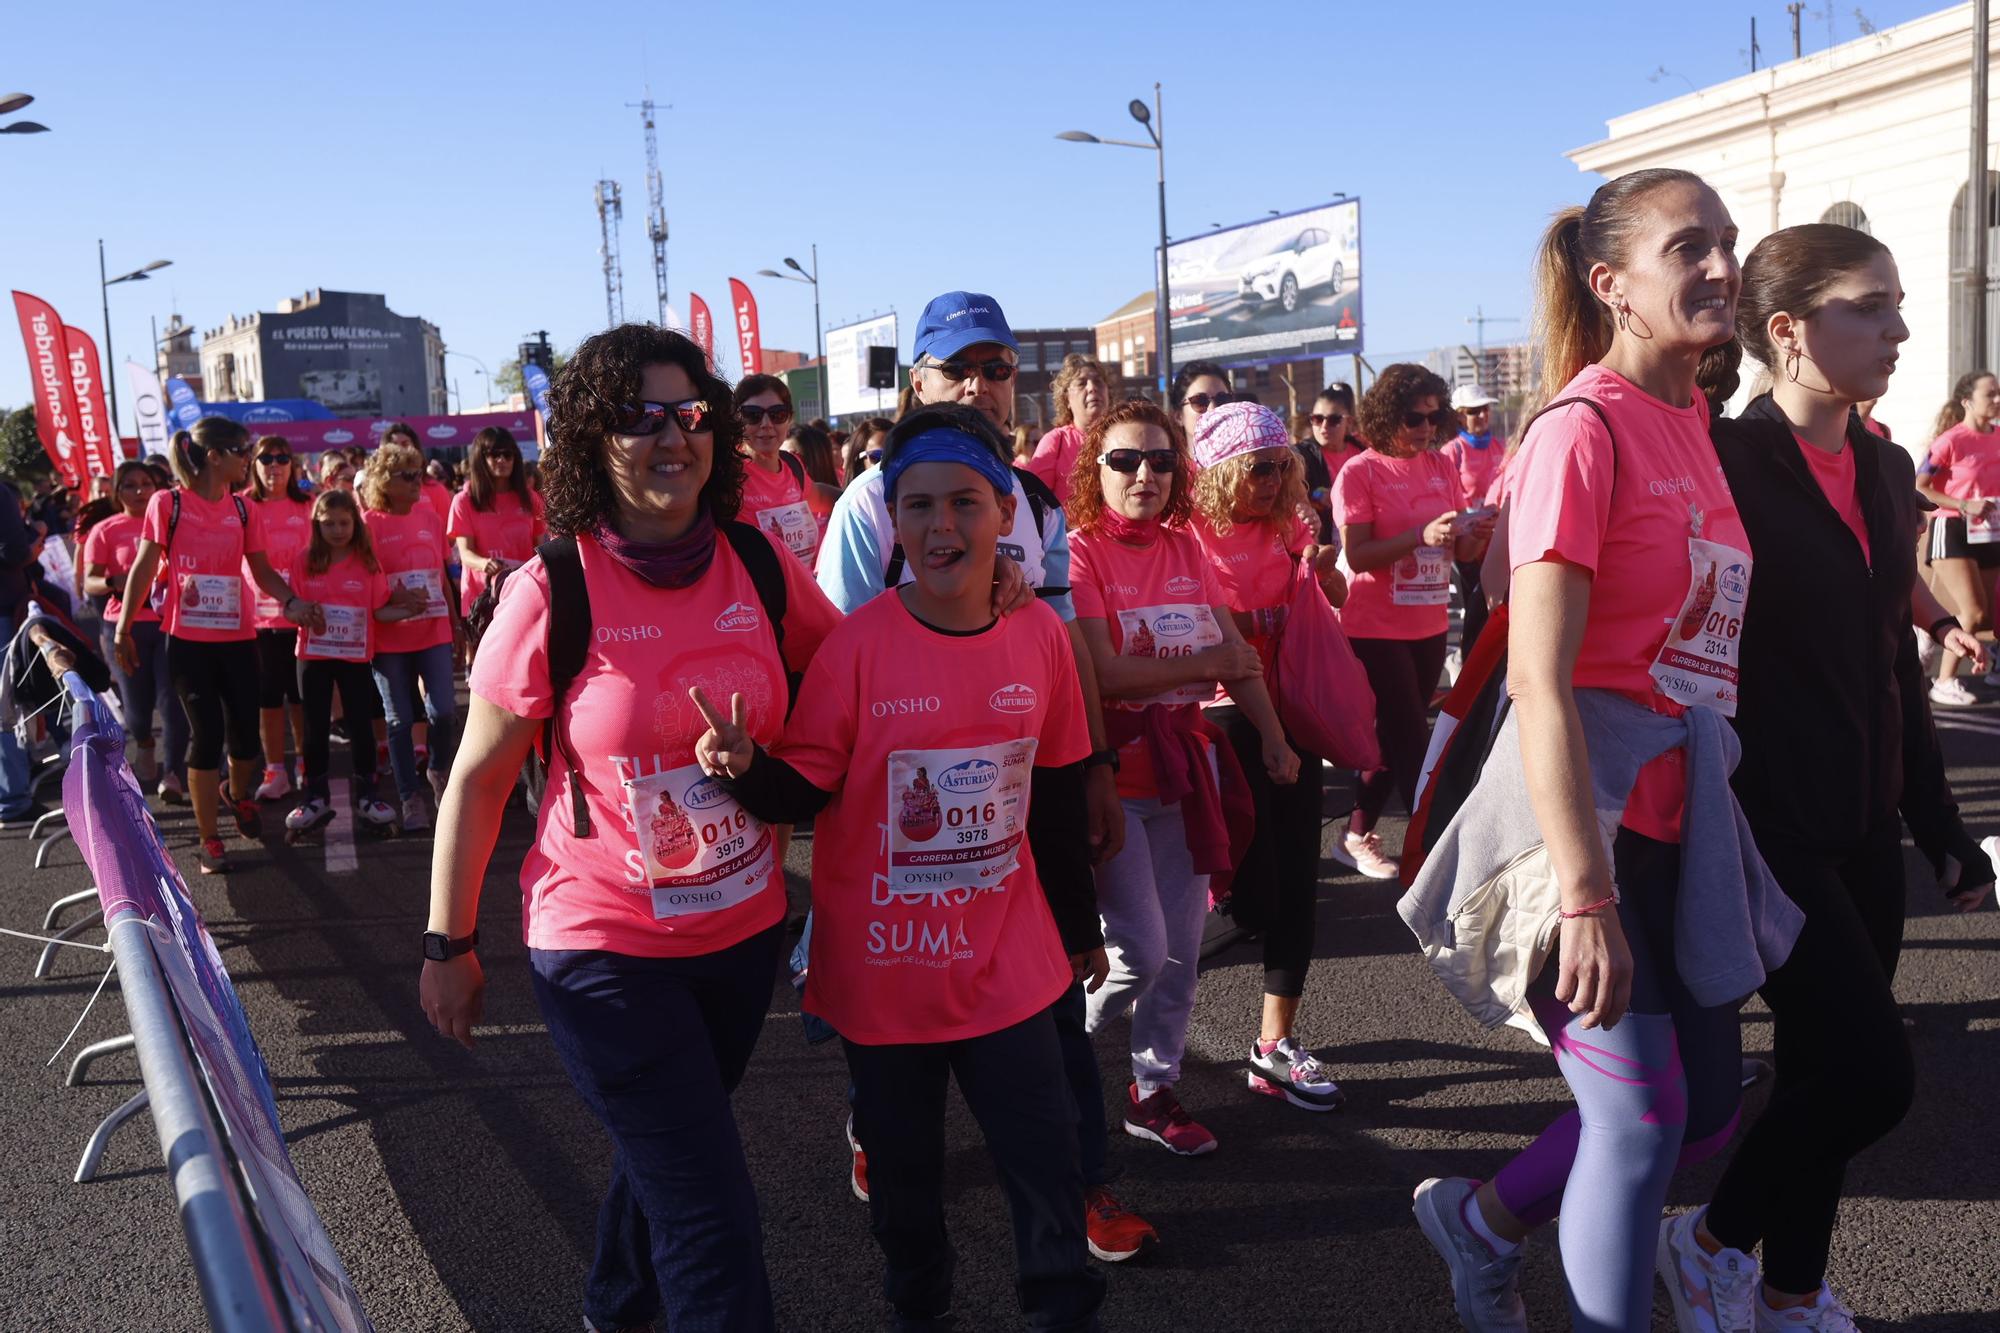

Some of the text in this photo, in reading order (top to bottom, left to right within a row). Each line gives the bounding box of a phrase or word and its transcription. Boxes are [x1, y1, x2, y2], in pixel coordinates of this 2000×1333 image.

[287, 326, 329, 340] PUERTO
[785, 529, 804, 543] 016
[179, 555, 196, 569] TU
[1420, 564, 1440, 575] 016
[202, 596, 223, 606] 016
[328, 625, 348, 635] 016
[1706, 611, 1741, 638] 016
[597, 626, 662, 643] OYSHO
[1159, 645, 1193, 659] 016
[1705, 640, 1727, 657] 2314
[1671, 654, 1700, 668] CARRERA
[1700, 662, 1710, 671] DE
[1711, 665, 1720, 674] LA
[872, 696, 941, 718] OYSHO
[1002, 756, 1025, 767] SUMA
[943, 771, 995, 787] ASTURIANA
[946, 802, 996, 827] 016
[702, 807, 747, 845] 016
[957, 828, 988, 844] 3978
[715, 836, 745, 859] 3979
[909, 854, 953, 863] CARRERA
[956, 852, 968, 860] DE
[970, 851, 982, 859] LA
[983, 843, 1006, 857] MUJER
[671, 873, 718, 885] CARRERA
[719, 865, 731, 876] DE
[732, 861, 743, 870] LA
[905, 871, 953, 883] OYSHO
[669, 890, 723, 905] OYSHO
[867, 917, 968, 956] SUMA
[865, 956, 900, 967] CARRERA
[902, 955, 914, 963] DE
[915, 957, 925, 965] LA
[952, 950, 974, 960] 2023
